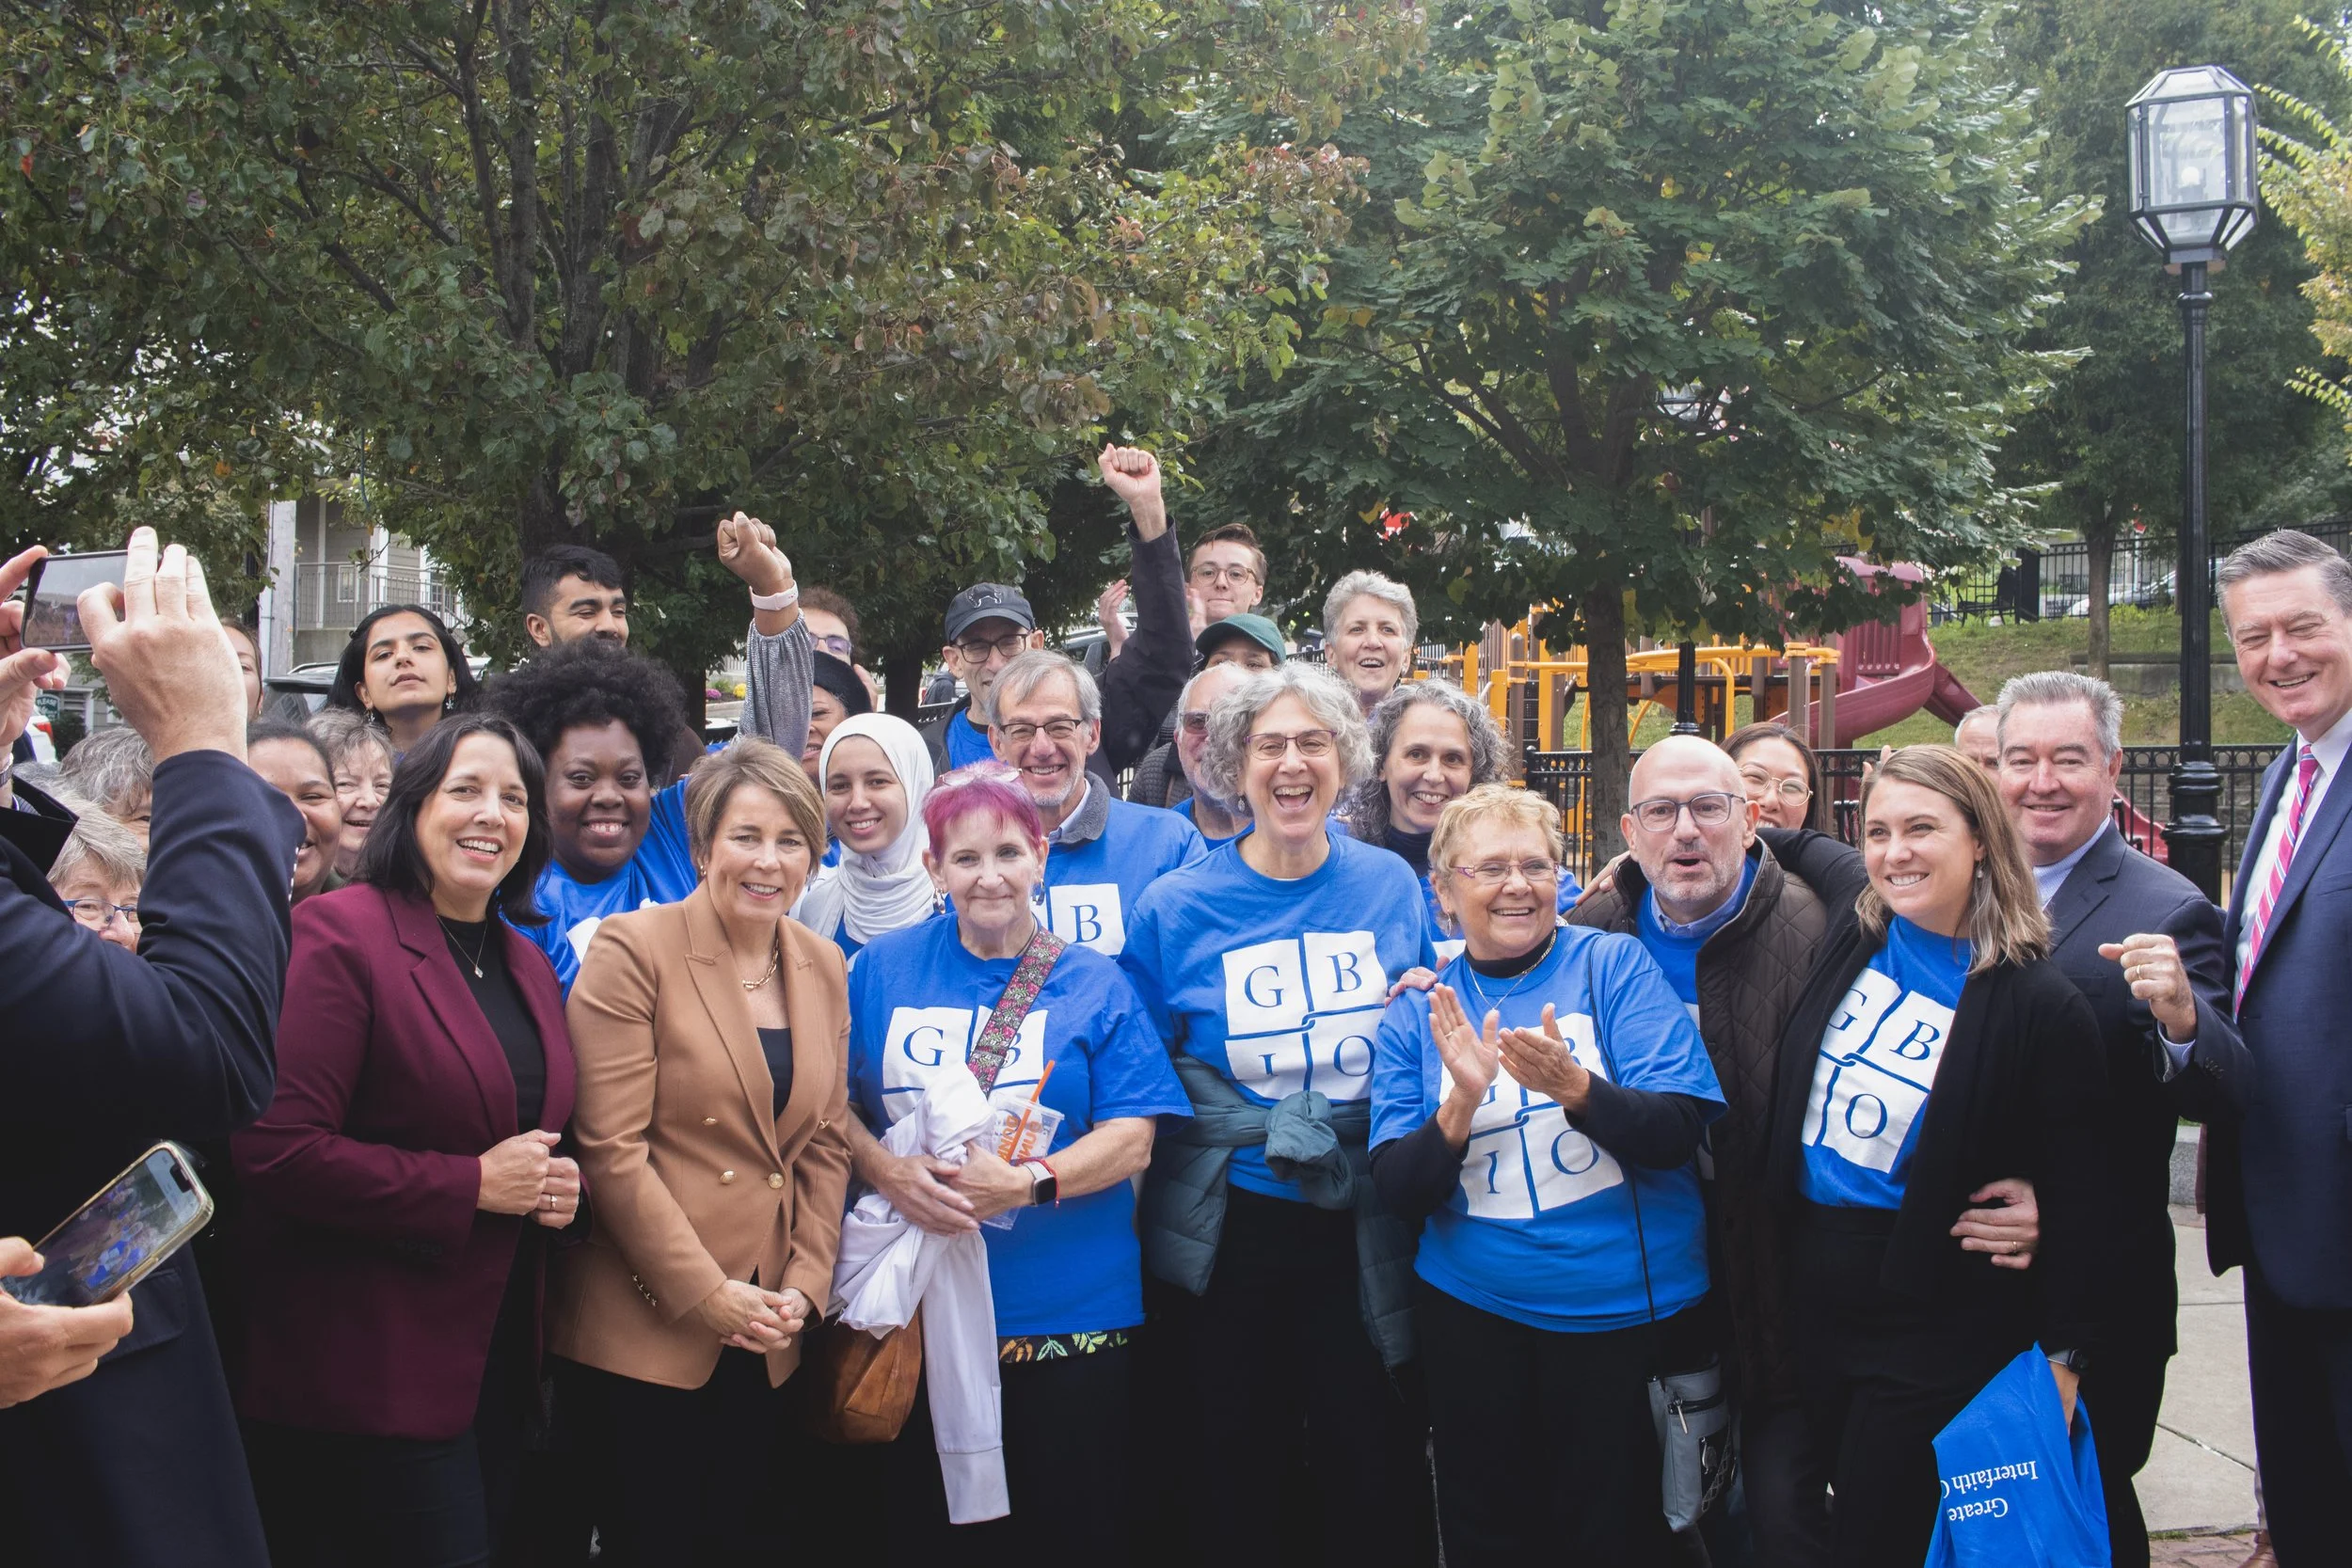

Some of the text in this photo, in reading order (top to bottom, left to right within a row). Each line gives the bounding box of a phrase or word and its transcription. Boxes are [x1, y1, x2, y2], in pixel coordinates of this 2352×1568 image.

[1070, 904, 1102, 943] B
[1244, 951, 1362, 1008] G B
[903, 1025, 946, 1067] G
[1258, 1035, 1377, 1077] I O
[1889, 1019, 1940, 1061] B
[1845, 1093, 1888, 1139] O
[1483, 1129, 1599, 1195] I O
[1951, 1460, 2039, 1494] Interfaith
